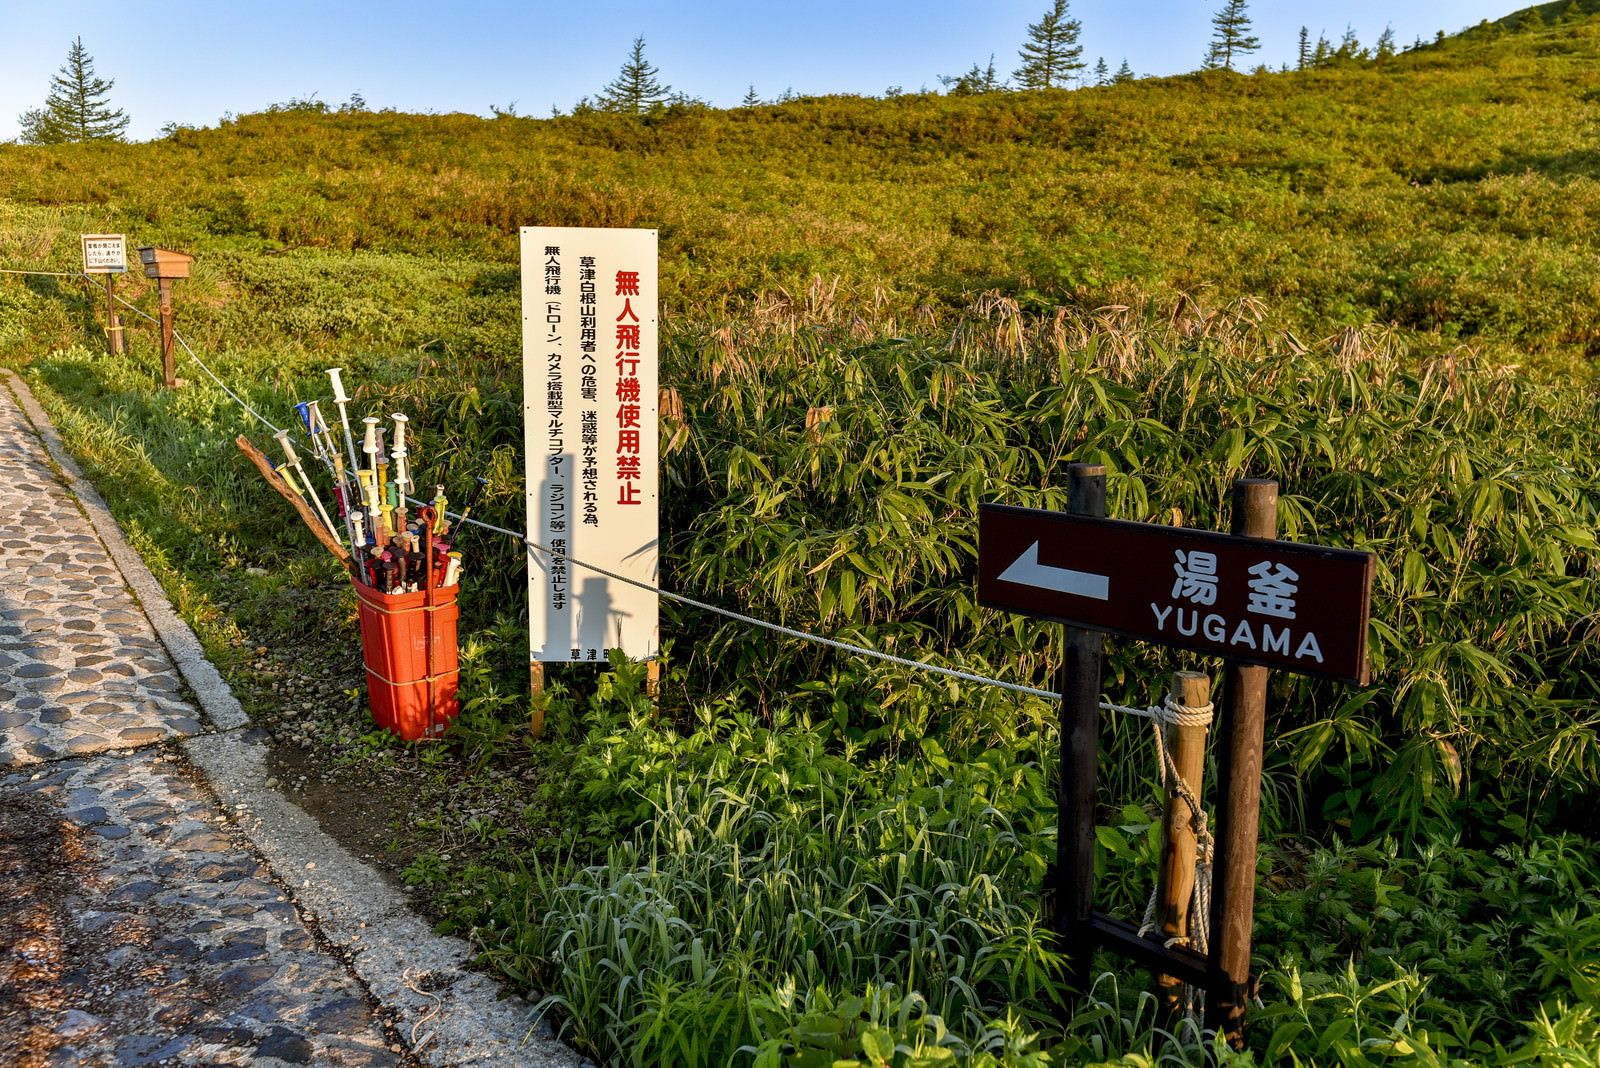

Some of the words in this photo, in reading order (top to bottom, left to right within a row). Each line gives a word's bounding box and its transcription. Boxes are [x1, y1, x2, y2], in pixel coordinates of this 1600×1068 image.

[579, 256, 599, 528] 草津白根山利用者への危害、迷惑等が予想される為、
[615, 270, 641, 505] 無人飛行機使用禁止
[1150, 602, 1324, 664] YUGAMA
[1171, 549, 1300, 620] 湯釜
